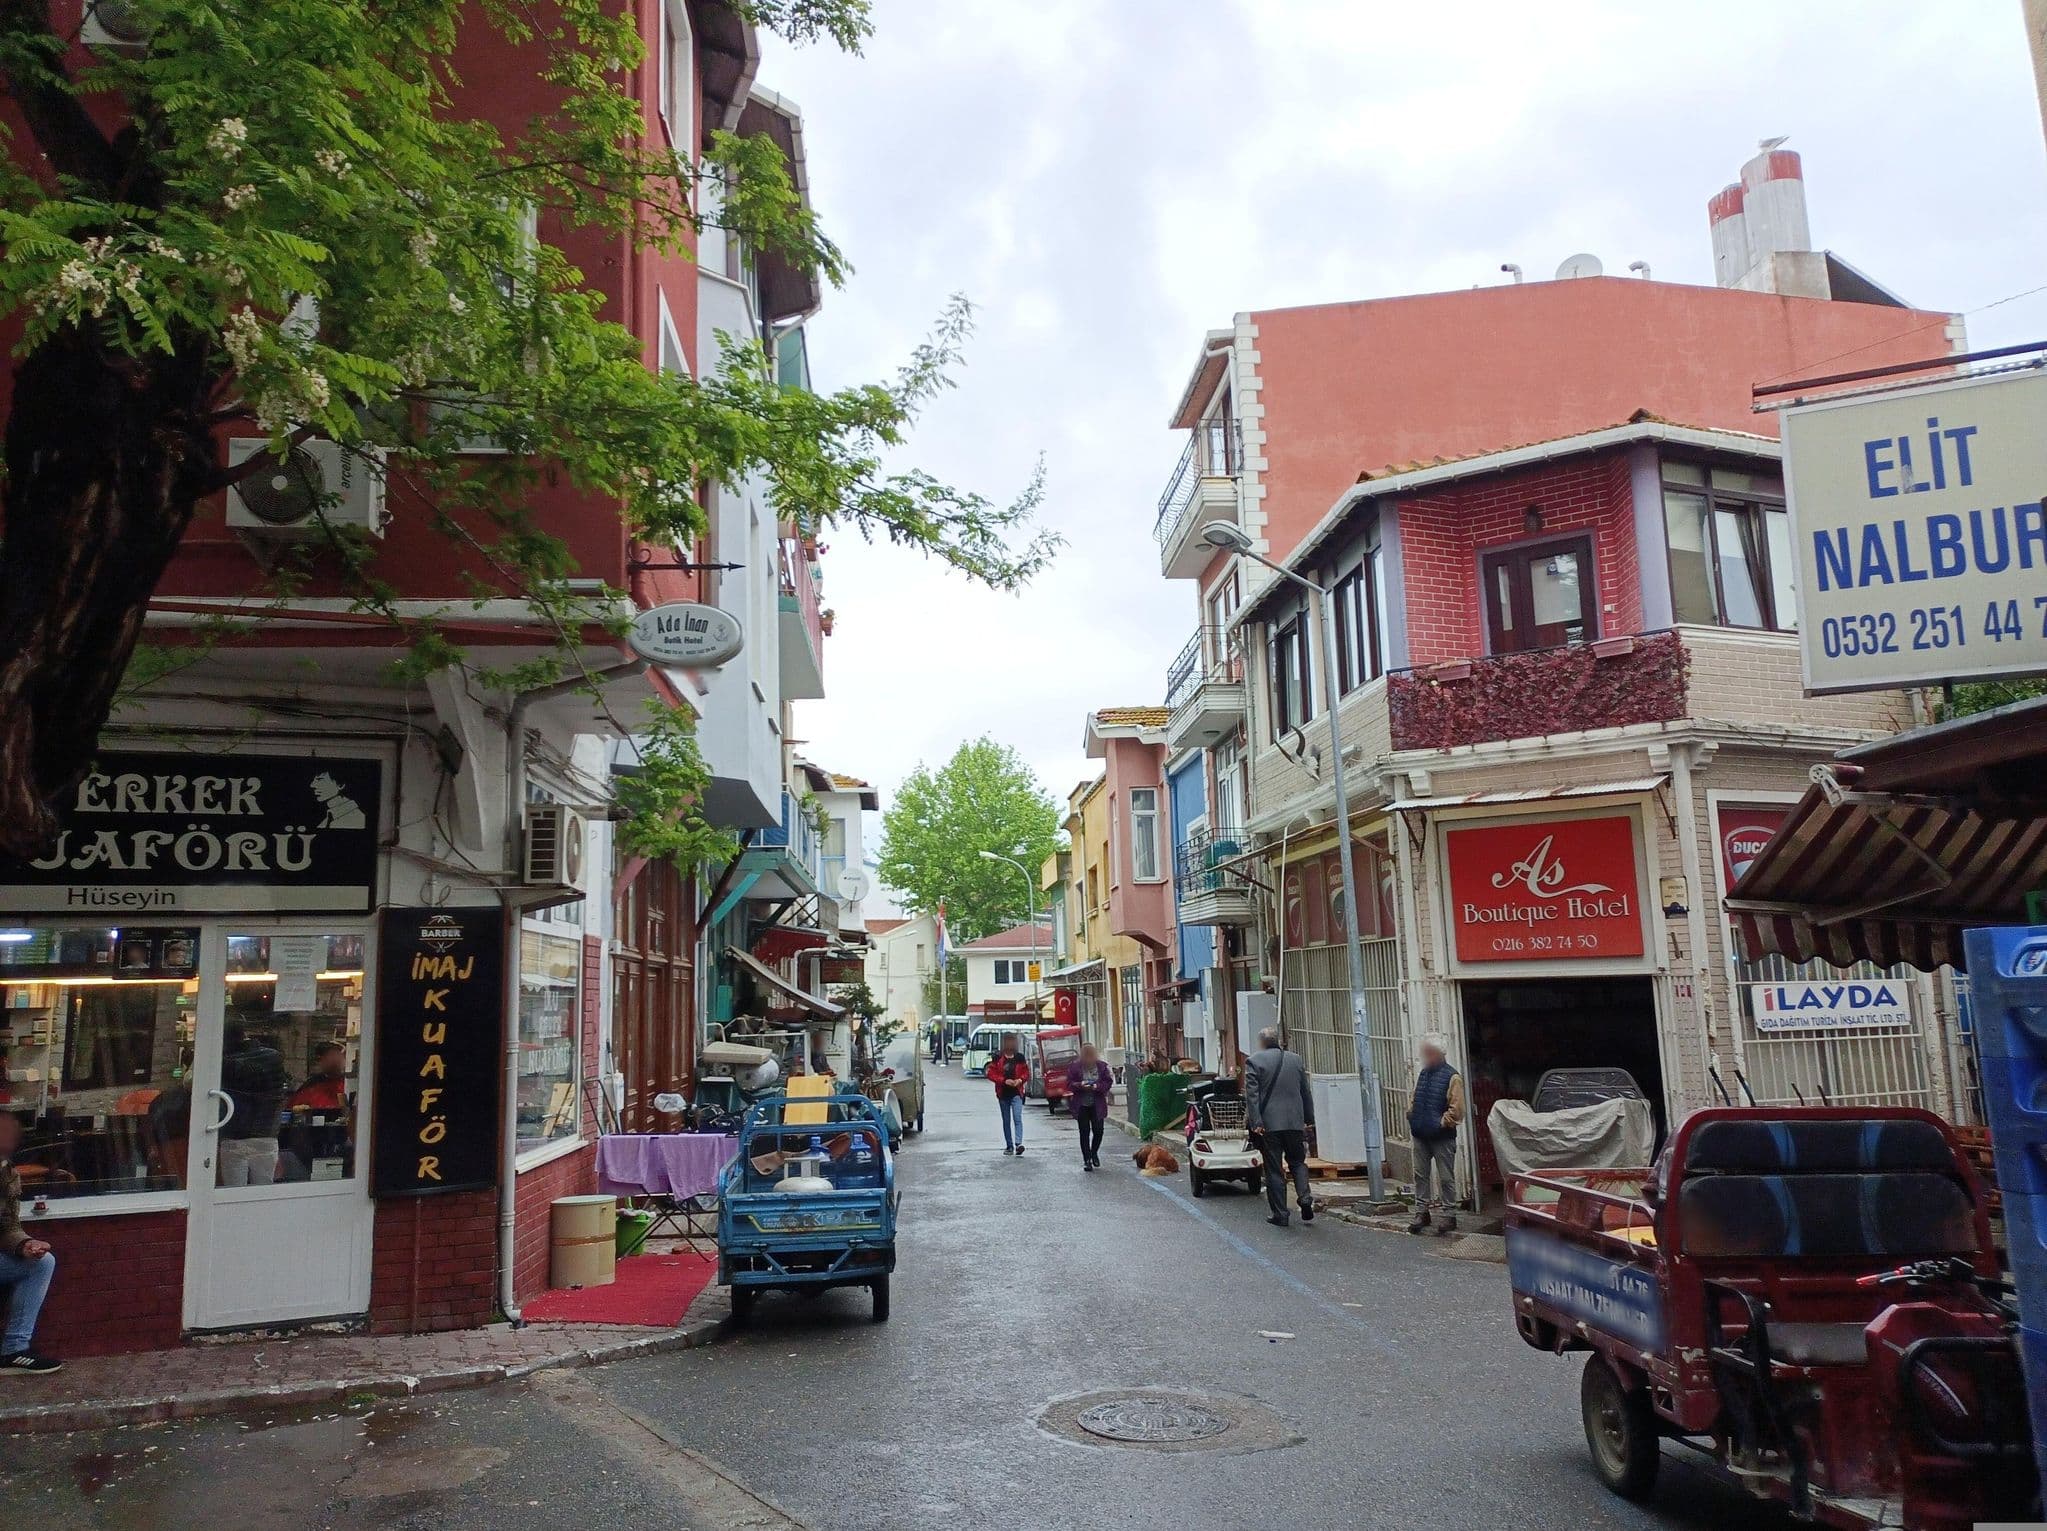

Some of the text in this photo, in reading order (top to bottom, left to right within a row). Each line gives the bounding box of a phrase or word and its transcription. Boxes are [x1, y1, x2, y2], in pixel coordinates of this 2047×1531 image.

[1864, 416, 1978, 499] ELİT
[1812, 502, 2047, 592] NALBUR
[657, 611, 709, 634] Ada İnan
[1821, 611, 1899, 659] 0532
[1910, 604, 1966, 651] 251
[1984, 598, 2023, 643] 44
[73, 773, 265, 815] ERKEK
[1491, 834, 1614, 898] As
[67, 887, 176, 910] Hüseyin
[1463, 894, 1630, 928] Boutique Hotel
[421, 929, 461, 938] BARBER
[1492, 934, 1598, 951] 0216 382 74 50
[411, 952, 475, 982] İMAJ
[1761, 1018, 1779, 1029] GIDA
[1780, 1015, 1810, 1028] DAĞITIM
[1811, 1014, 1838, 1026] TURİZM
[417, 987, 448, 1182] KUAFÖR
